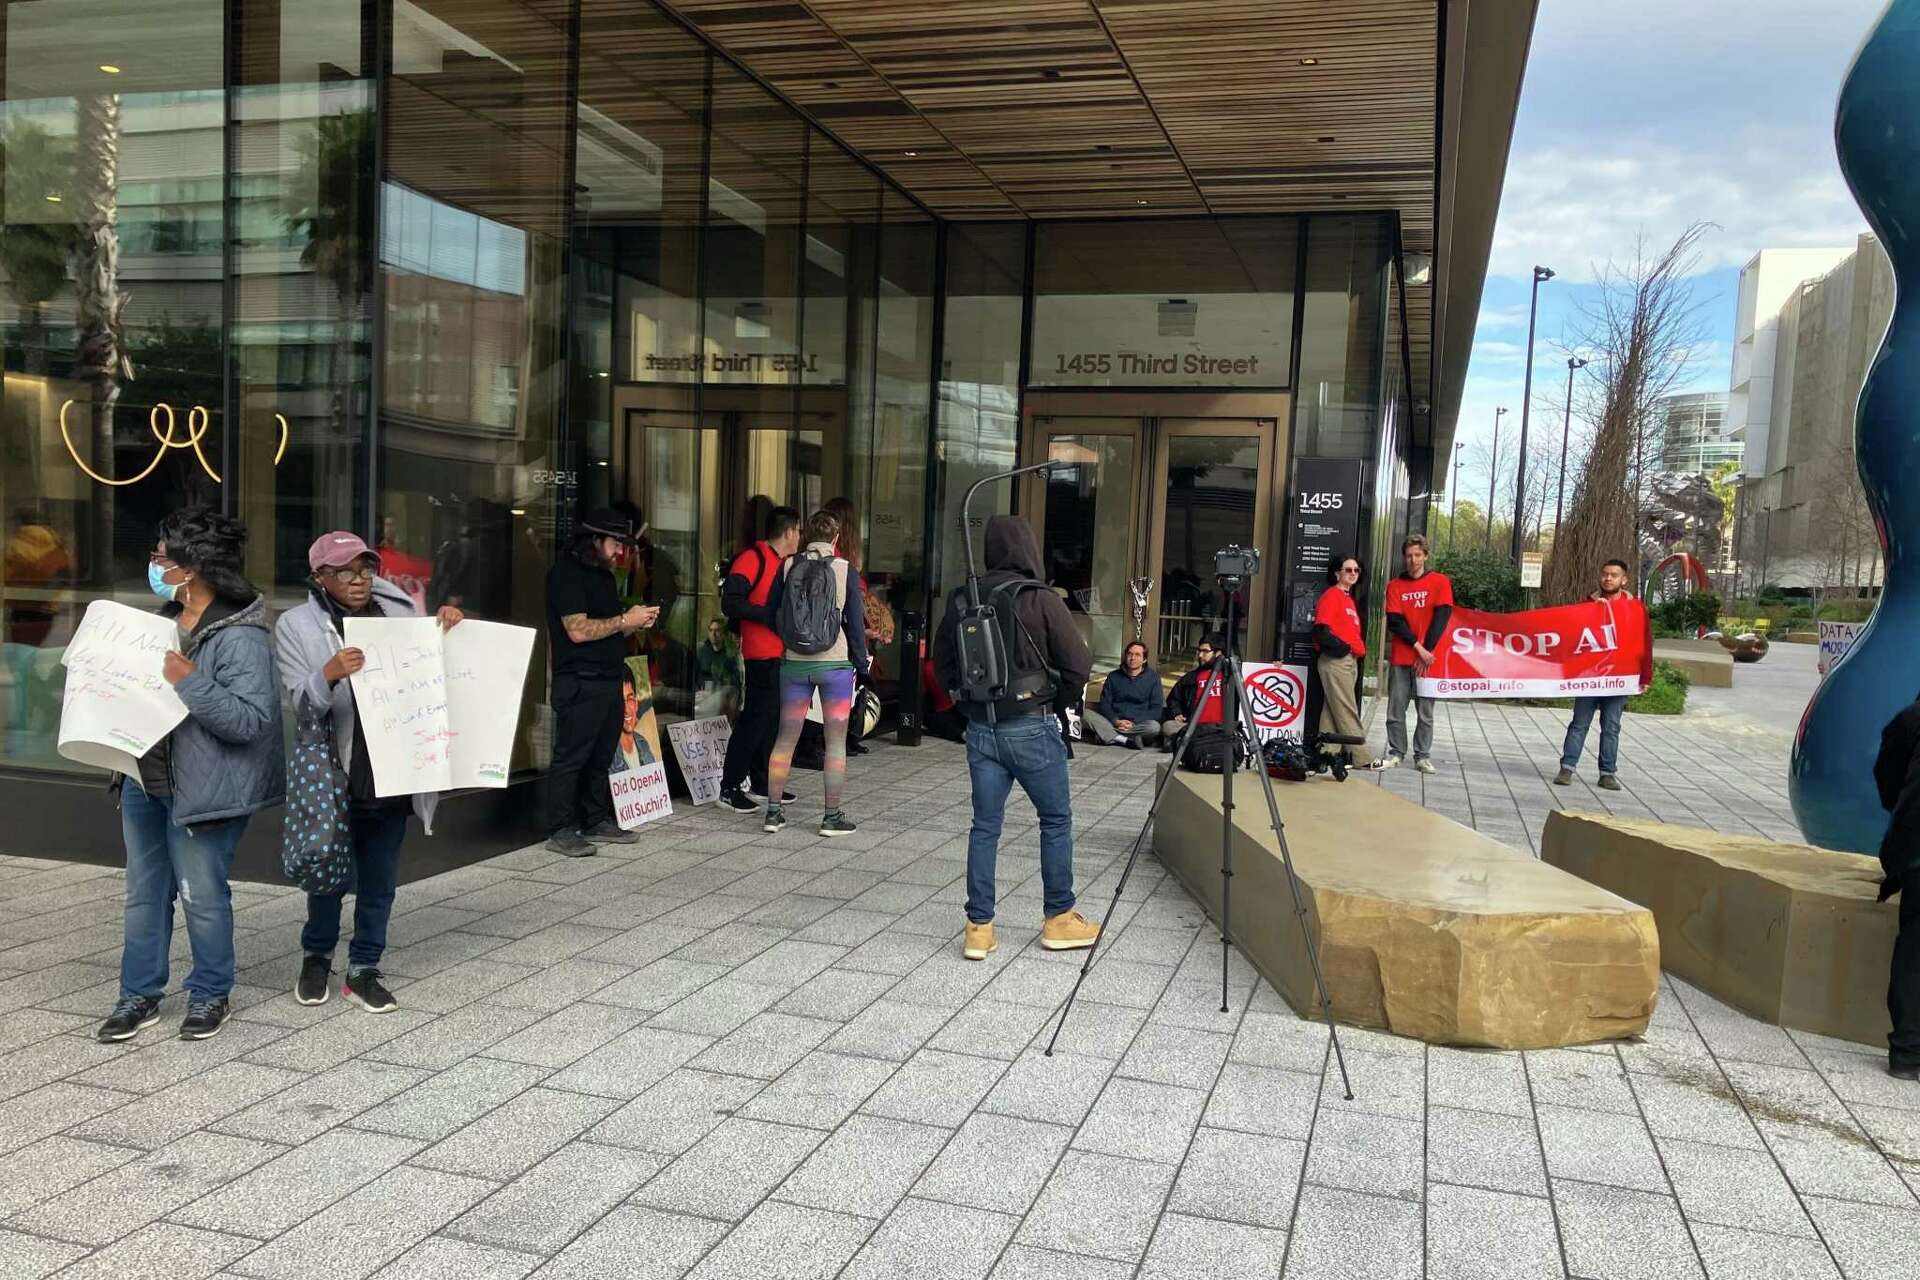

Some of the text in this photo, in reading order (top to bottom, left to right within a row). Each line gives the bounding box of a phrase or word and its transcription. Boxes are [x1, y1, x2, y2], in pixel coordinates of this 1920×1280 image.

[1056, 353, 1258, 374] 1455 Third Street
[1300, 492, 1343, 509] 1455
[957, 516, 983, 528] 155
[1401, 591, 1428, 601] STOP
[1414, 600, 1426, 609] AI
[1452, 623, 1618, 656] STOP AI
[1820, 623, 1854, 639] DATA
[1437, 677, 1625, 693] @stopai_info stopai.info
[680, 741, 711, 760] USES
[612, 781, 629, 797] Did
[629, 769, 664, 793] OpenAI
[618, 793, 669, 823] Kill Suchir?
